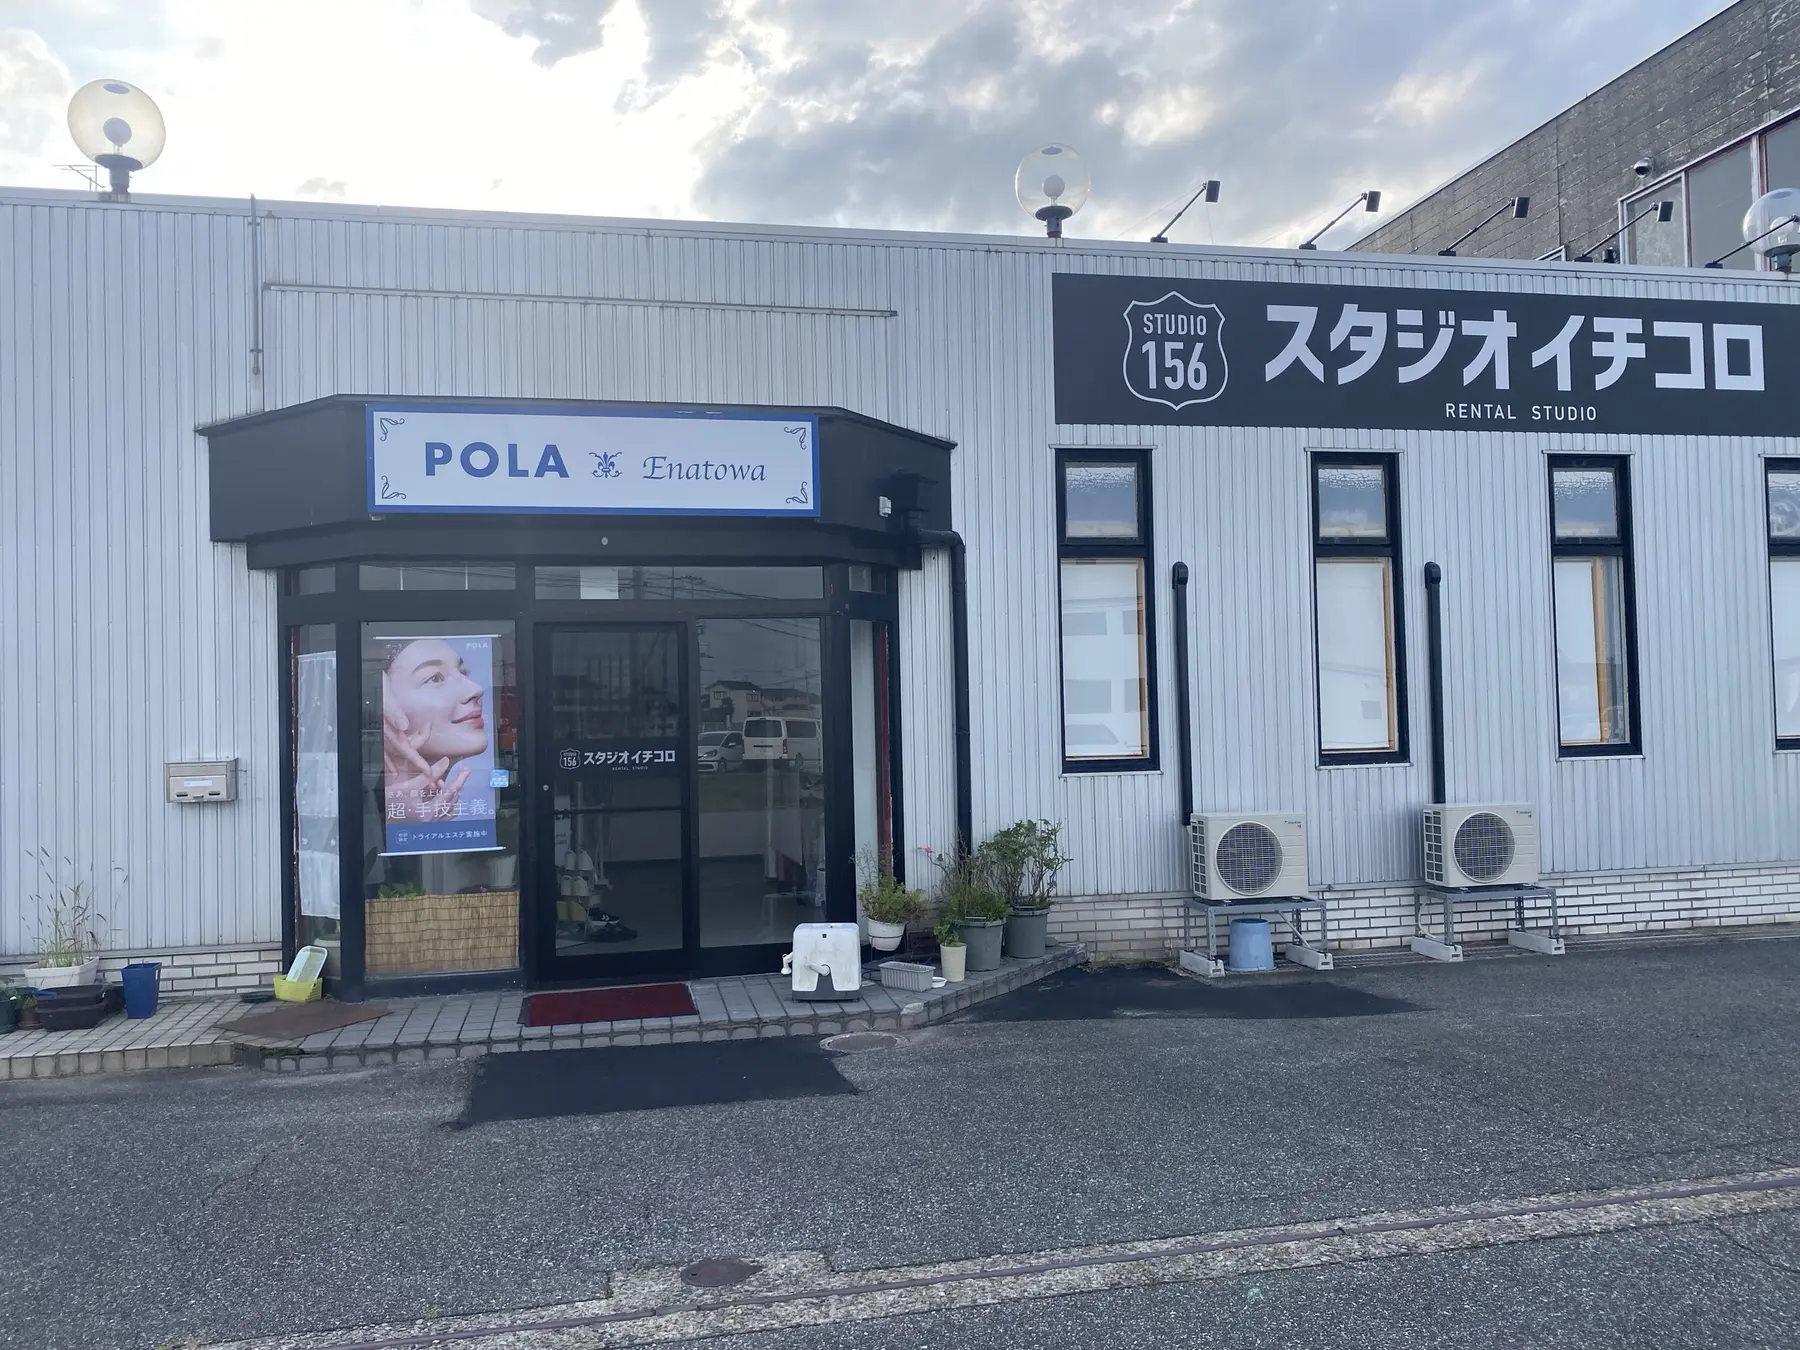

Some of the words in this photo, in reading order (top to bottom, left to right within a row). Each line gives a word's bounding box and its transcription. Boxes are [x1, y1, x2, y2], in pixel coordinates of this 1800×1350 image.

[1143, 313, 1207, 336] STUDIO
[1265, 303, 1765, 391] スタジオイチコロ
[1142, 341, 1208, 391] 156
[1445, 402, 1517, 420] RENTAL
[1531, 405, 1597, 422] STUDIO
[425, 441, 570, 478] POLA
[642, 456, 766, 481] Enatowa
[563, 757, 577, 767] 156
[583, 750, 676, 765] スタジオイチコロ
